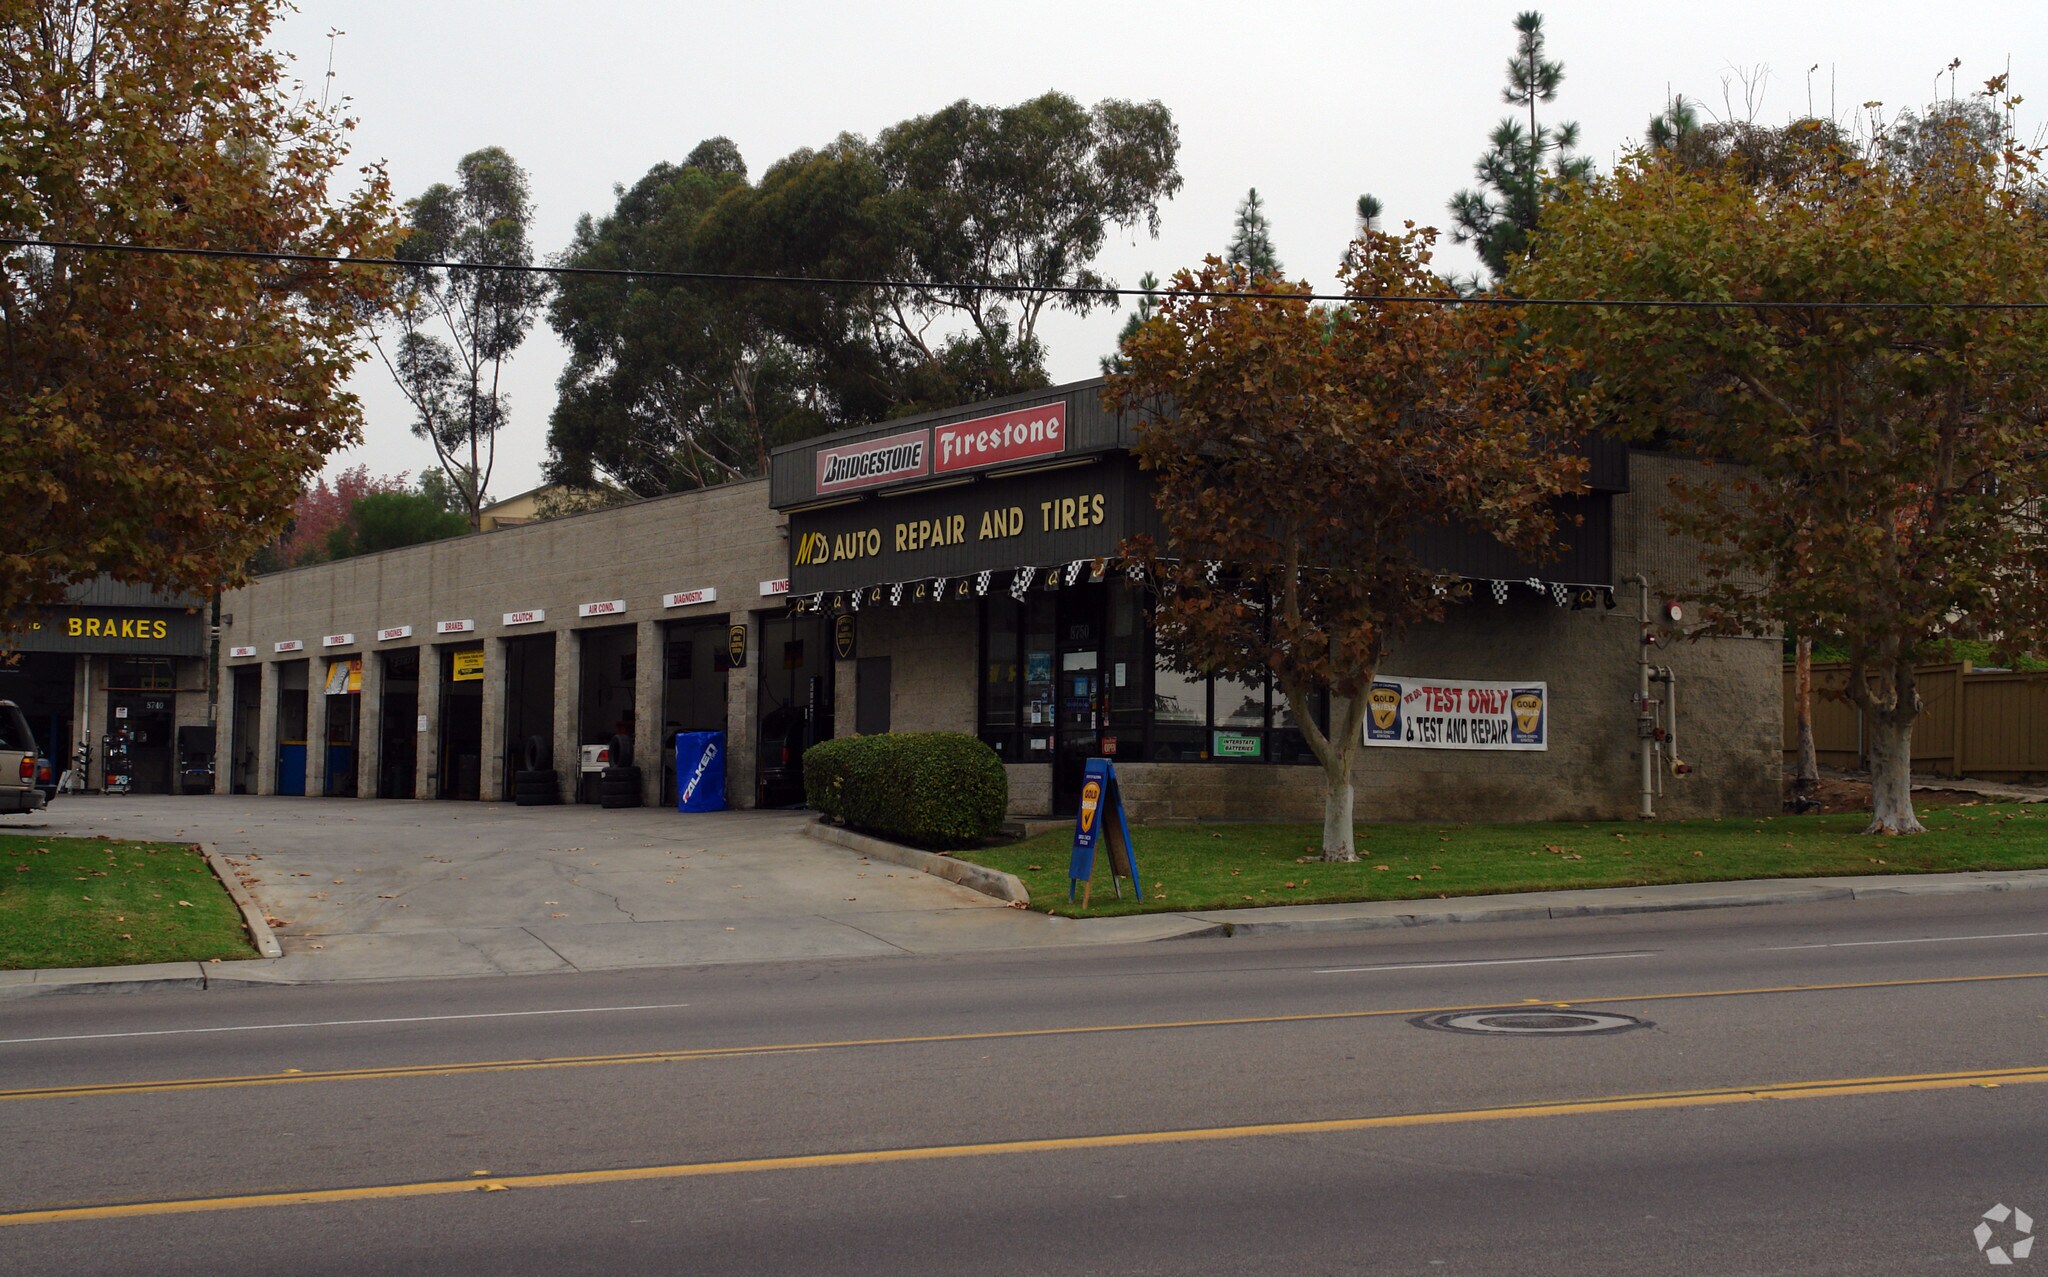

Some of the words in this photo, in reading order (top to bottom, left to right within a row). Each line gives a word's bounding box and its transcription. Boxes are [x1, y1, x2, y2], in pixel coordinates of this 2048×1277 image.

[941, 416, 1060, 465] Firestone
[823, 443, 923, 483] BRIDGESTONE
[833, 528, 882, 561] AUTO
[895, 514, 966, 552] REPAIR
[979, 506, 1024, 540] AND
[1041, 494, 1105, 532] TIRES
[673, 590, 703, 605] DIAGNOSTIC
[588, 604, 598, 614] AIR
[598, 602, 615, 613] COND.
[512, 612, 534, 622] CLUTCH
[68, 617, 168, 640] BRAKES
[384, 628, 402, 638] ENGINES
[445, 622, 464, 631] BRAKES
[1070, 624, 1090, 640] 8750
[330, 636, 344, 644] TIRES
[1374, 694, 1395, 702] GOLD
[1422, 686, 1463, 712] TEST
[1468, 688, 1509, 714] ONLY
[1517, 700, 1537, 708] GOLD
[1372, 704, 1396, 712] SHIELD
[1406, 716, 1414, 742] &
[1417, 717, 1443, 742] TEST
[1446, 718, 1468, 744] AND
[1471, 718, 1508, 744] REPAIR
[682, 743, 718, 804] FALKEN
[1085, 790, 1098, 798] GOLD
